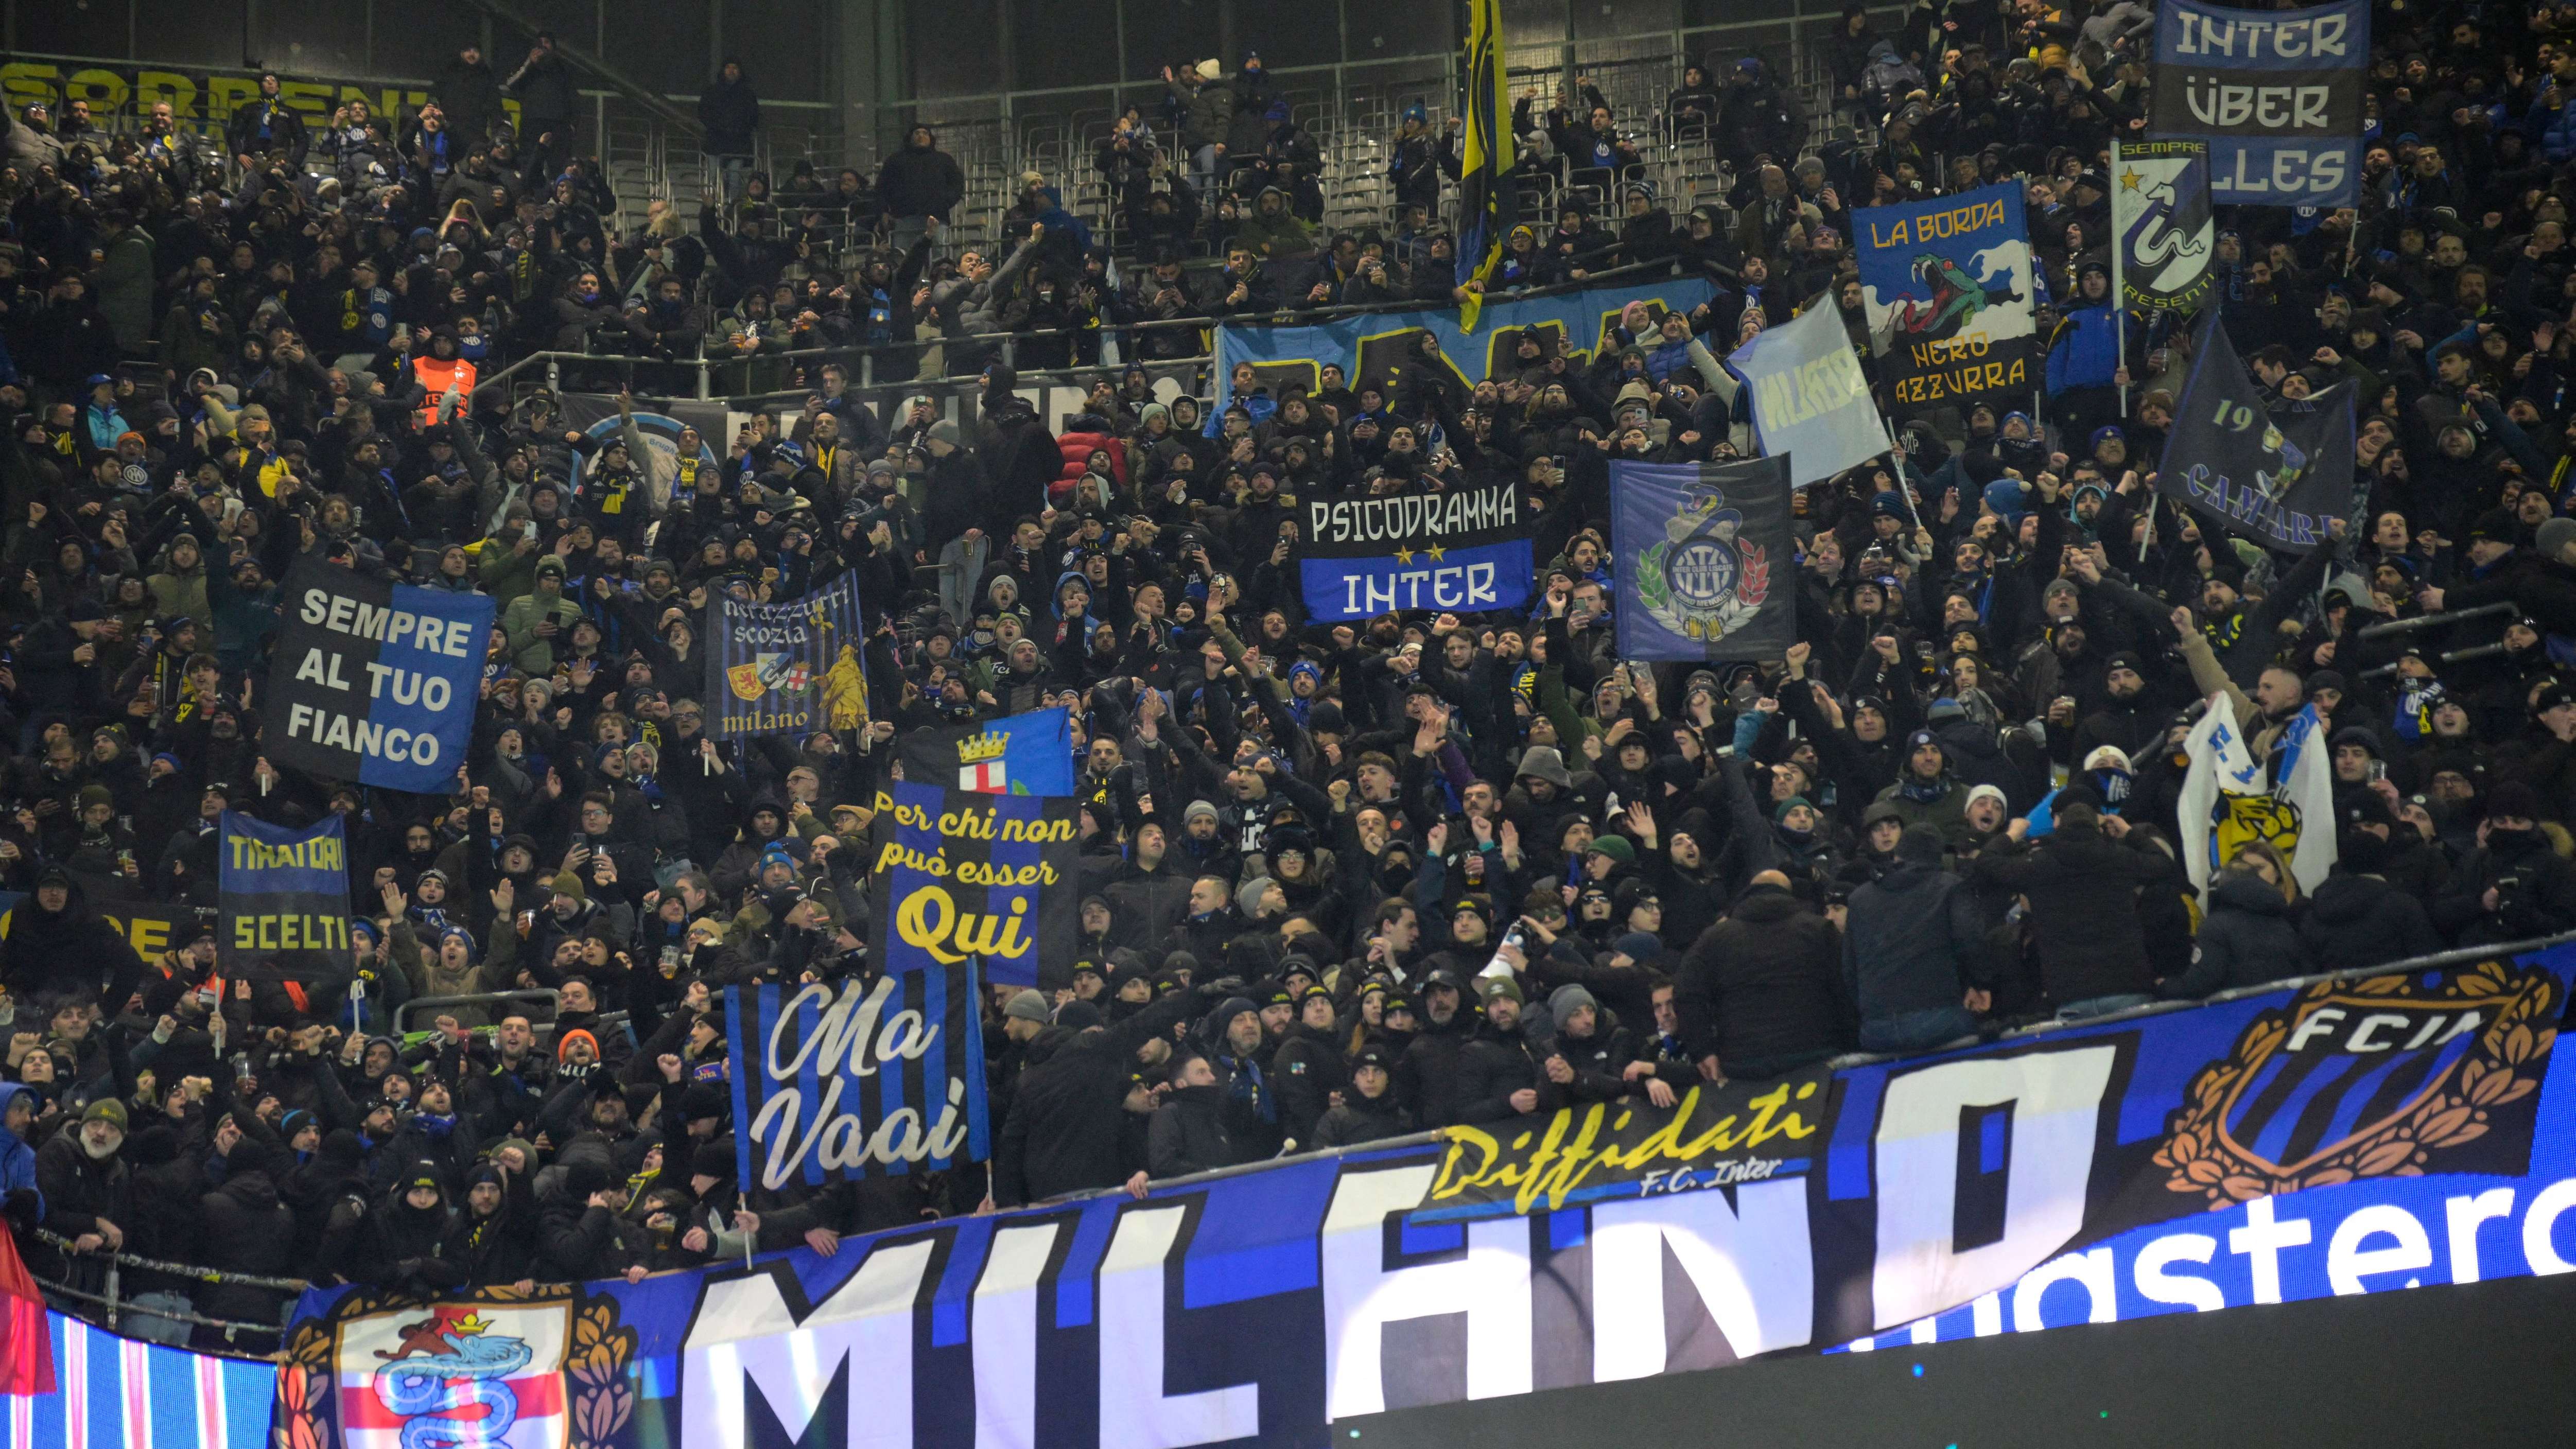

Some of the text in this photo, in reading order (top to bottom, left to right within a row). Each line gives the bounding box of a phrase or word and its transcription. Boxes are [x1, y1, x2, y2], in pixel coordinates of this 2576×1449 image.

[2177, 11, 2347, 58] INTER
[2186, 76, 2329, 128] ÜBER
[2121, 142, 2207, 155] SEMPRE
[1871, 199, 2005, 248] LA BORDA
[1911, 331, 1989, 368] NERO
[1895, 358, 2026, 404] AZZURRA
[1311, 482, 1516, 543] PSICODRAMMA
[723, 584, 849, 623] nerazzurri
[1343, 562, 1496, 613] INTER
[300, 588, 472, 658] SEMPRE
[734, 625, 808, 647] scozia
[295, 647, 451, 711] AL TUO
[287, 703, 439, 766] FIANCO
[721, 710, 808, 734] milano
[937, 807, 998, 840] chi
[1000, 818, 1077, 843] non
[874, 841, 1059, 886] può esser
[234, 914, 347, 950] SCELTI
[896, 885, 1033, 965] Qui
[768, 975, 939, 1080] Ma
[749, 1074, 967, 1191] Vaai
[1432, 1081, 1818, 1215] Diffidati
[1703, 1157, 1784, 1189] Inter
[680, 1044, 2116, 1449] MILANO
